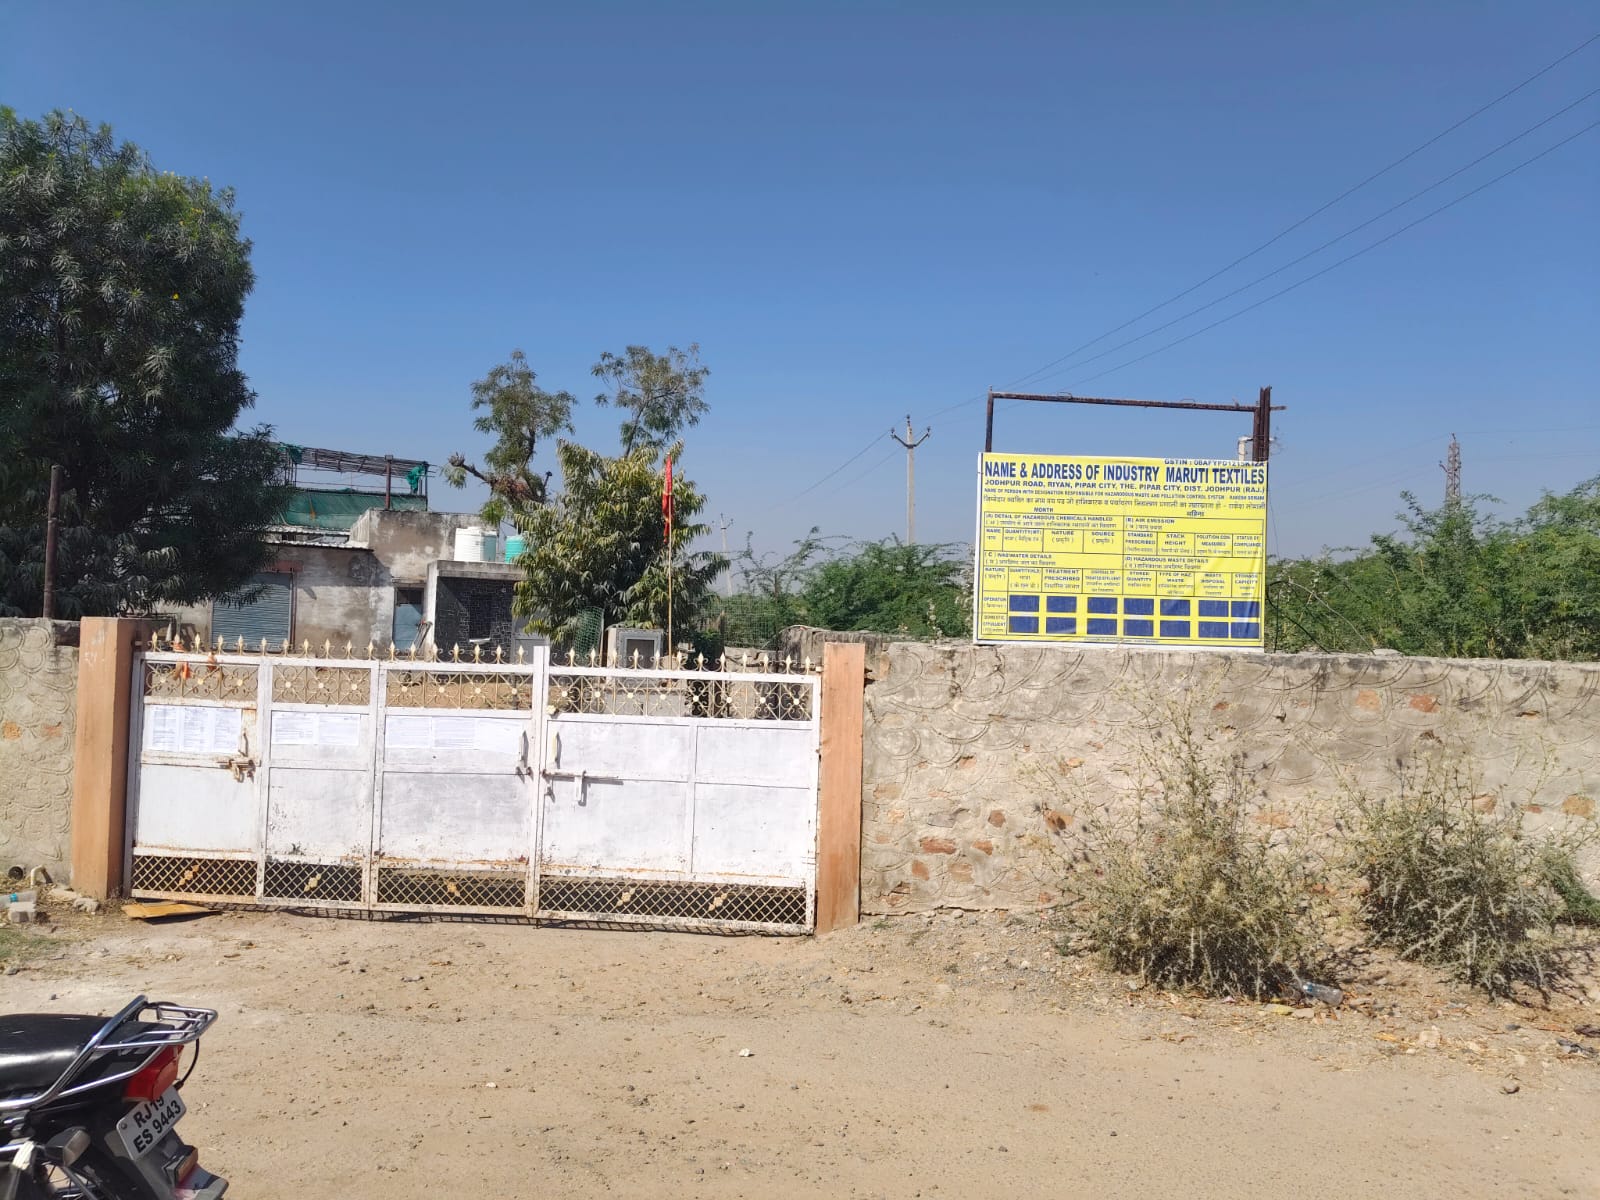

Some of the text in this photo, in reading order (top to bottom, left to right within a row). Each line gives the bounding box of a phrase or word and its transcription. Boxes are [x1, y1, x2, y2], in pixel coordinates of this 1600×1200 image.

[985, 461, 1264, 484] NAME & ADDRESS OF INDUSTRY MARUTI TEXTILES
[133, 1100, 180, 1153] ES 9443
